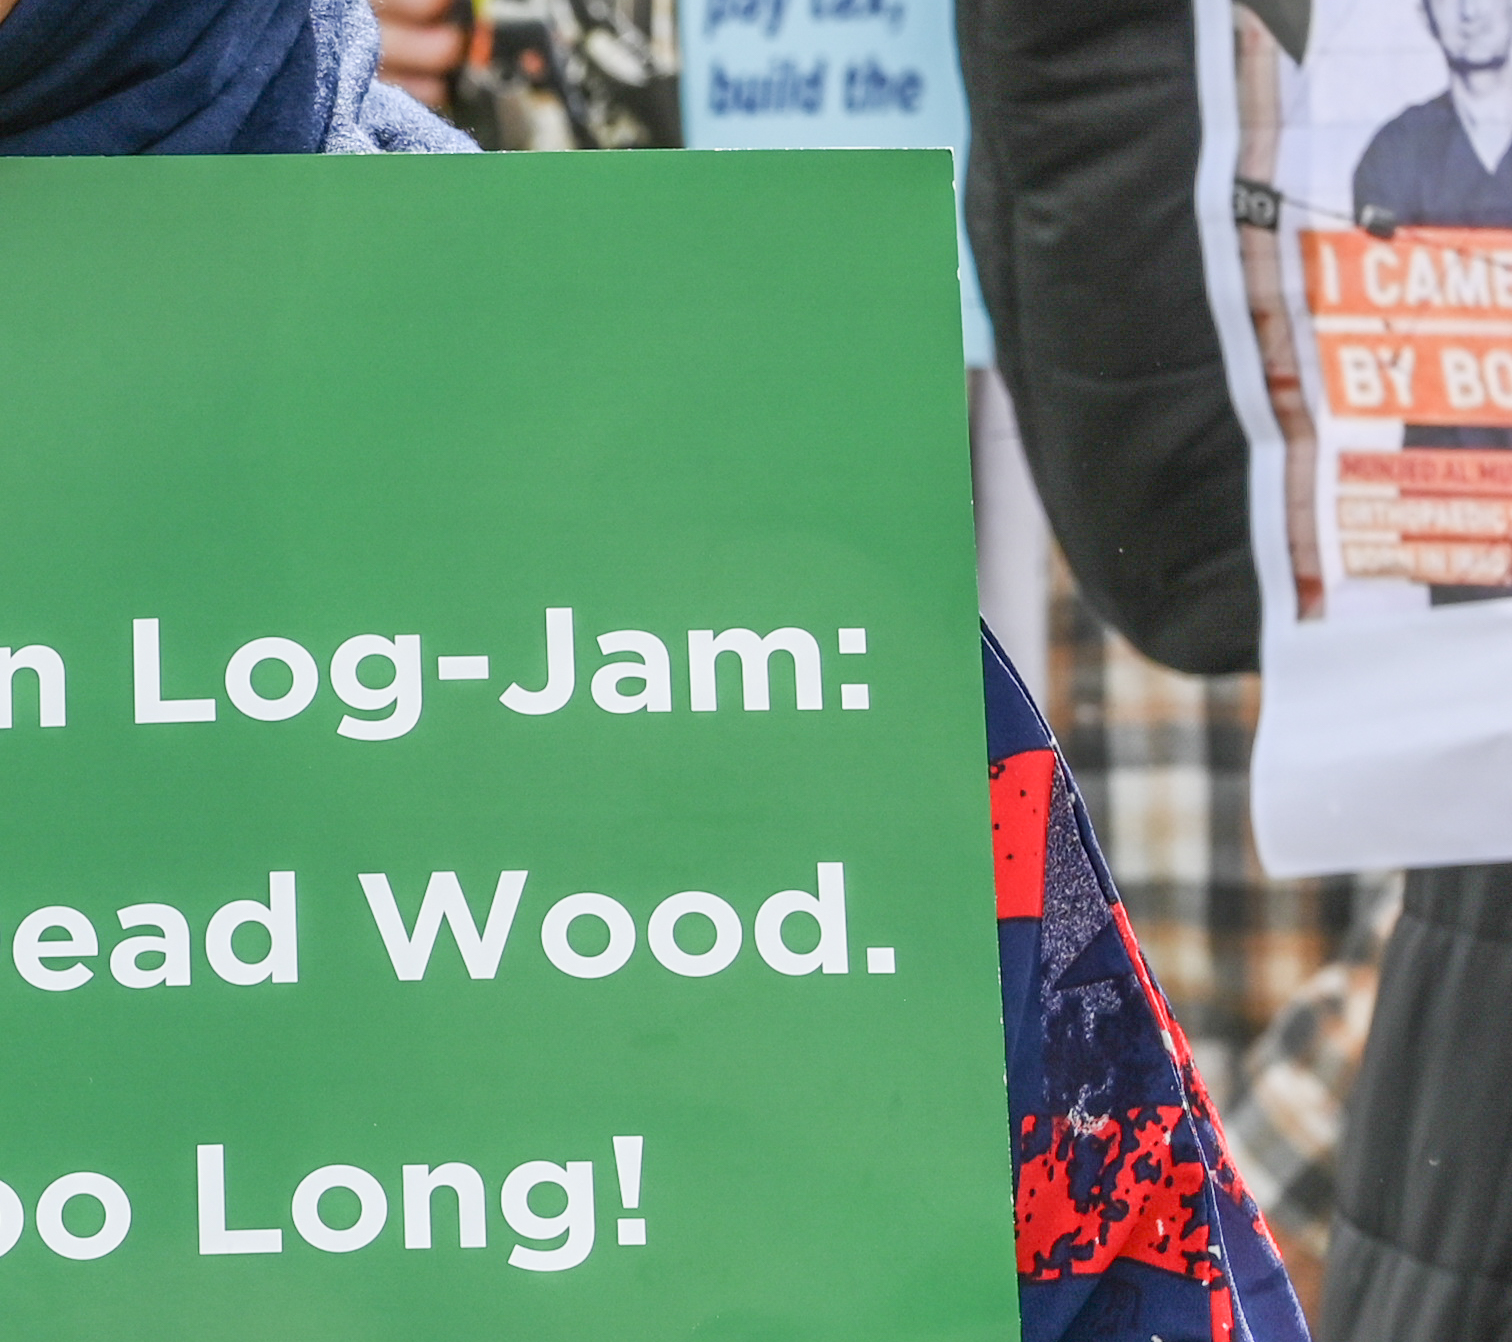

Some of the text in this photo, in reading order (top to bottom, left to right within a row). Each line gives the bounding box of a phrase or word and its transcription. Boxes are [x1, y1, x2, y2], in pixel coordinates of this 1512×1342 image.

[707, 61, 926, 117] build the
[1318, 247, 1341, 305] I
[1335, 344, 1417, 409] BY
[131, 606, 871, 742] Log-Jam:
[356, 861, 897, 982] Wood.
[196, 1134, 648, 1273] Long!
